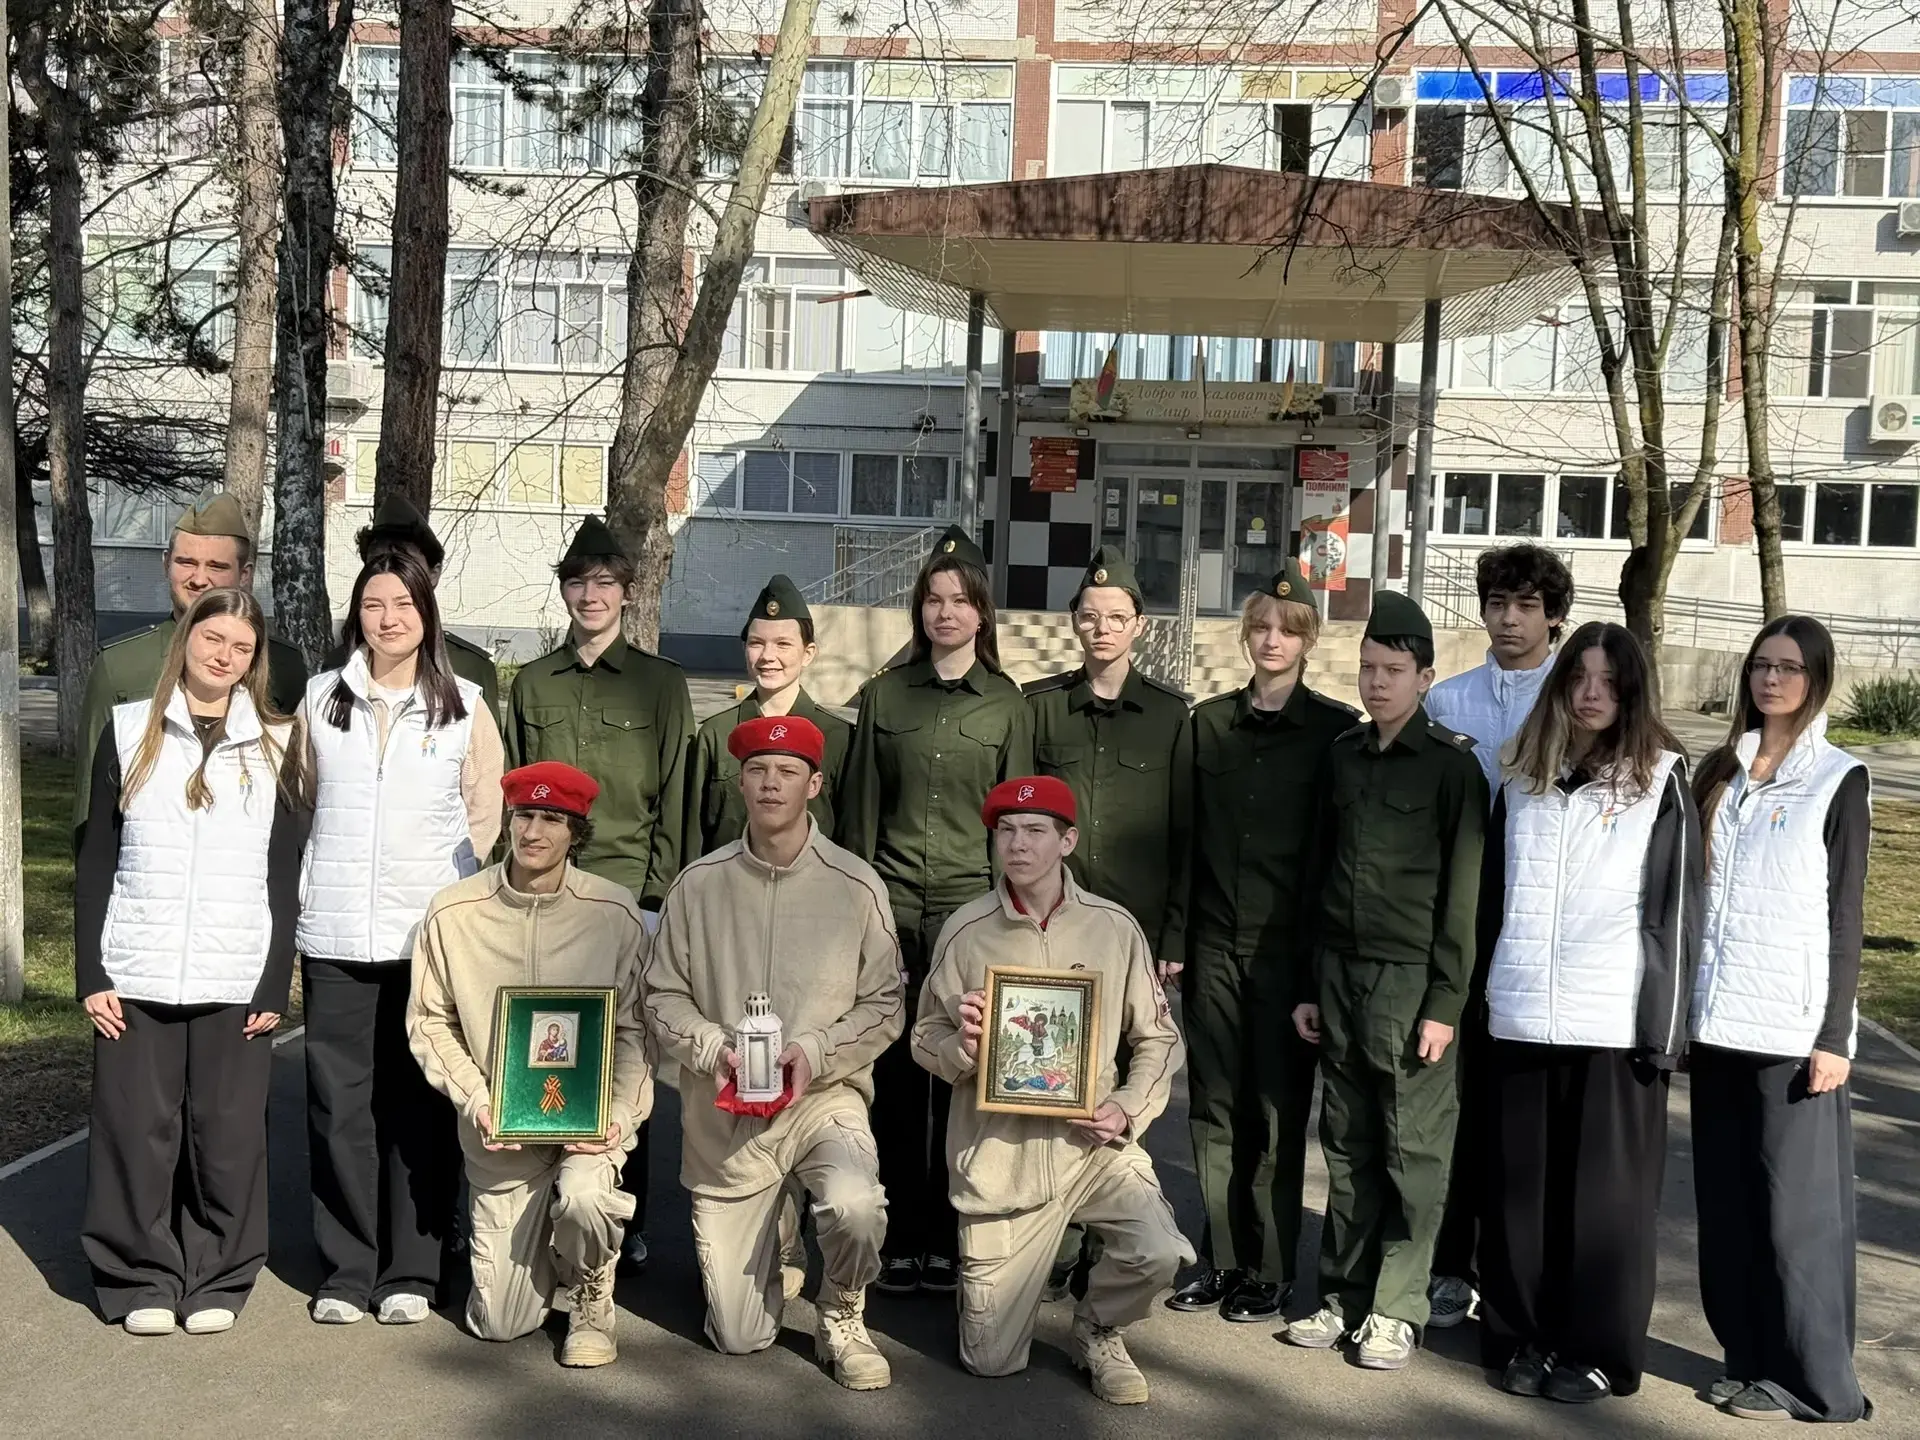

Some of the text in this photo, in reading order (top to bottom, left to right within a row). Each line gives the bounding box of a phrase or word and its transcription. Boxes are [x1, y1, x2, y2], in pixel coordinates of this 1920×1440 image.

[1129, 385, 1176, 403] Добро
[1196, 406, 1258, 419] наний!
[1305, 481, 1349, 492] ПОМНИМ!
